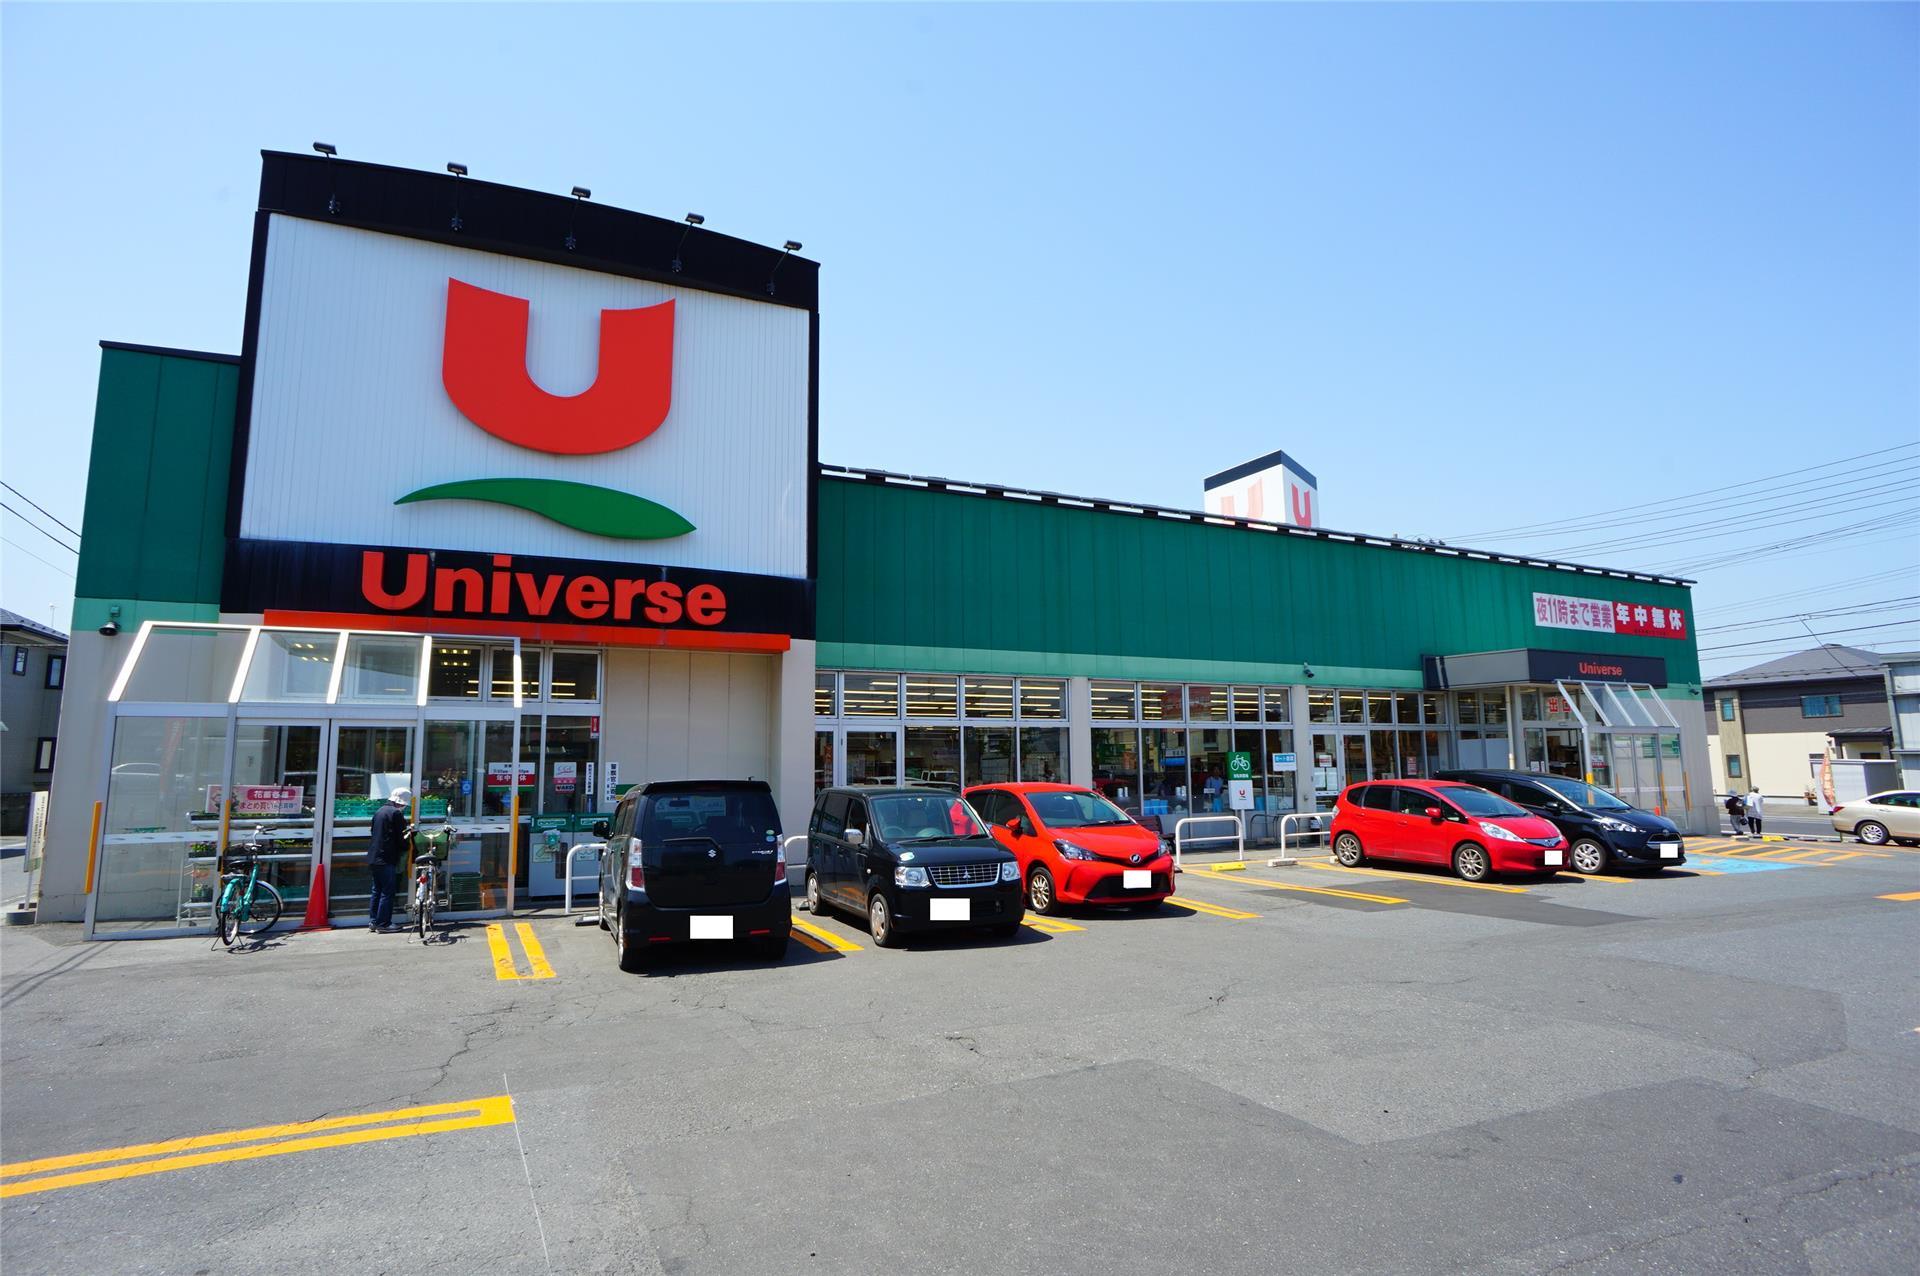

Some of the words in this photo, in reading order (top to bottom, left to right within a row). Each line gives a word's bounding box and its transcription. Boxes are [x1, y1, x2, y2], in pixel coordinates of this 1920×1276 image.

[442, 276, 675, 455] U
[361, 550, 727, 626] Universe
[1536, 597, 1612, 629] 夜11時まで営業
[1616, 603, 1682, 630] 年中無休
[1579, 662, 1622, 677] Universe
[496, 774, 527, 782] 年中休
